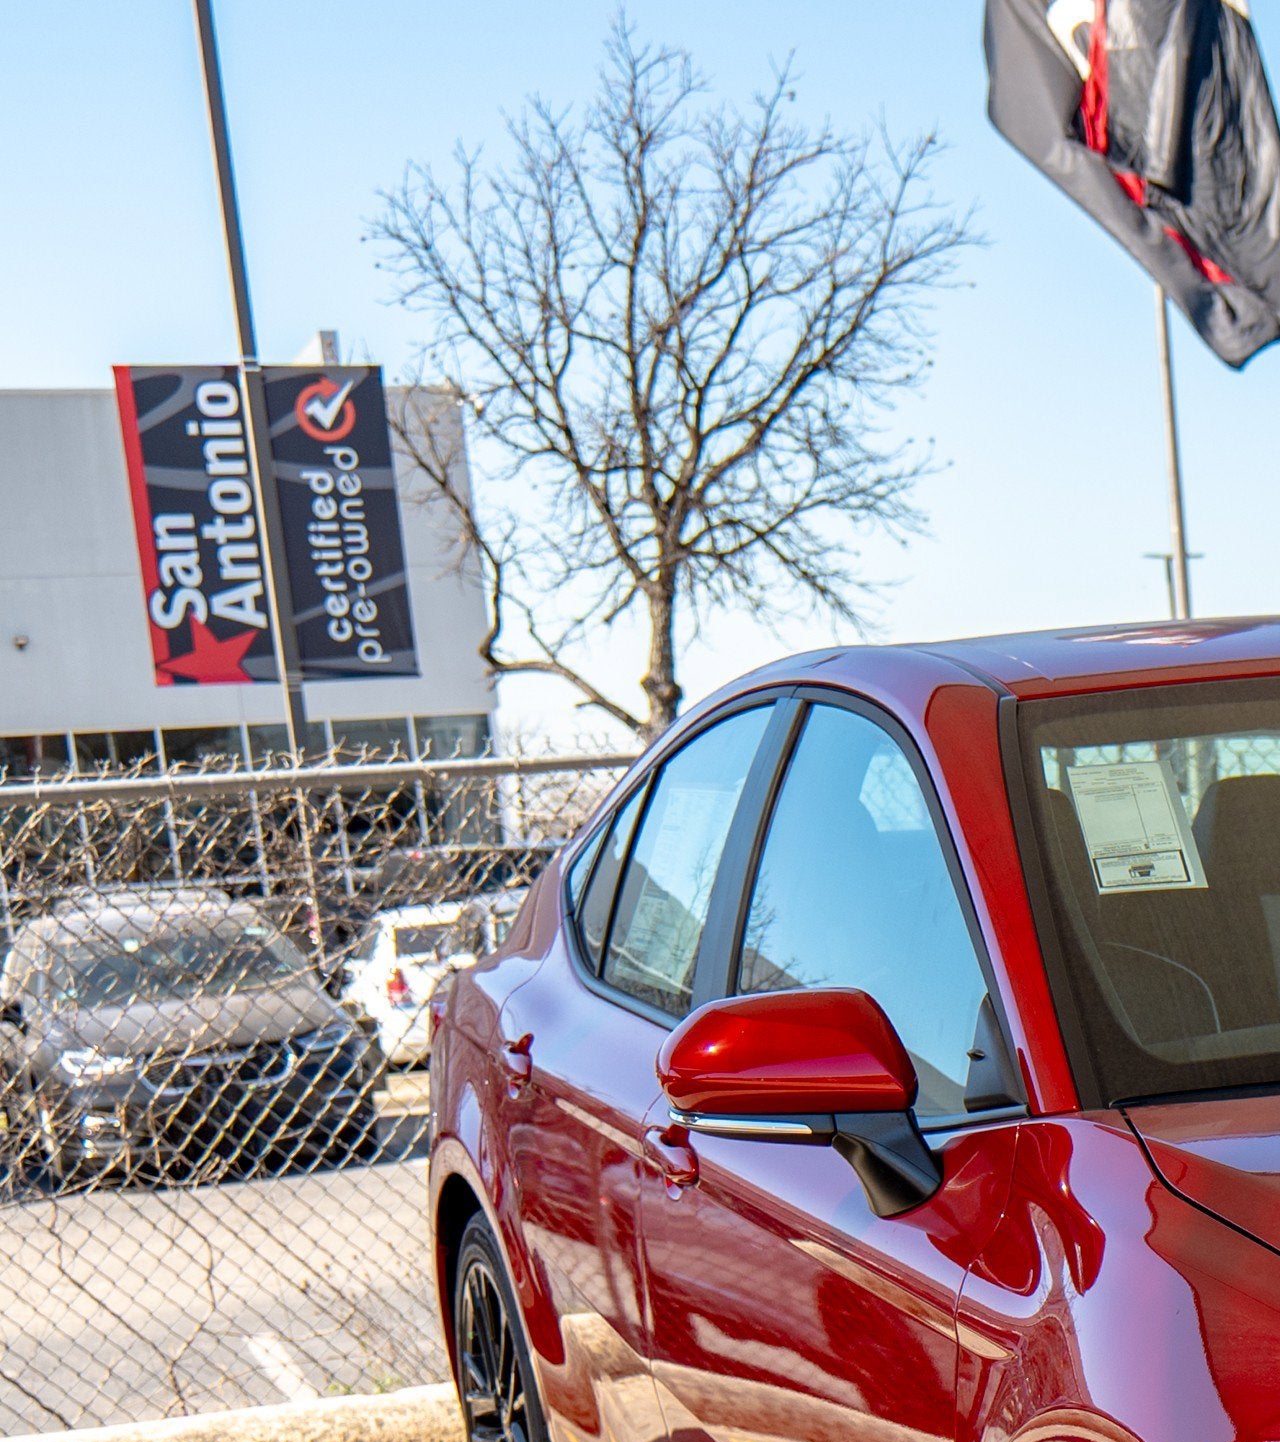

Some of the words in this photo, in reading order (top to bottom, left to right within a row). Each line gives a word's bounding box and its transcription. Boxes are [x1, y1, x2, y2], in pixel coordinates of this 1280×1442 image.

[150, 512, 208, 630] San
[185, 380, 269, 630] Antonio
[300, 469, 354, 643] certified
[324, 446, 393, 664] pre-owned
